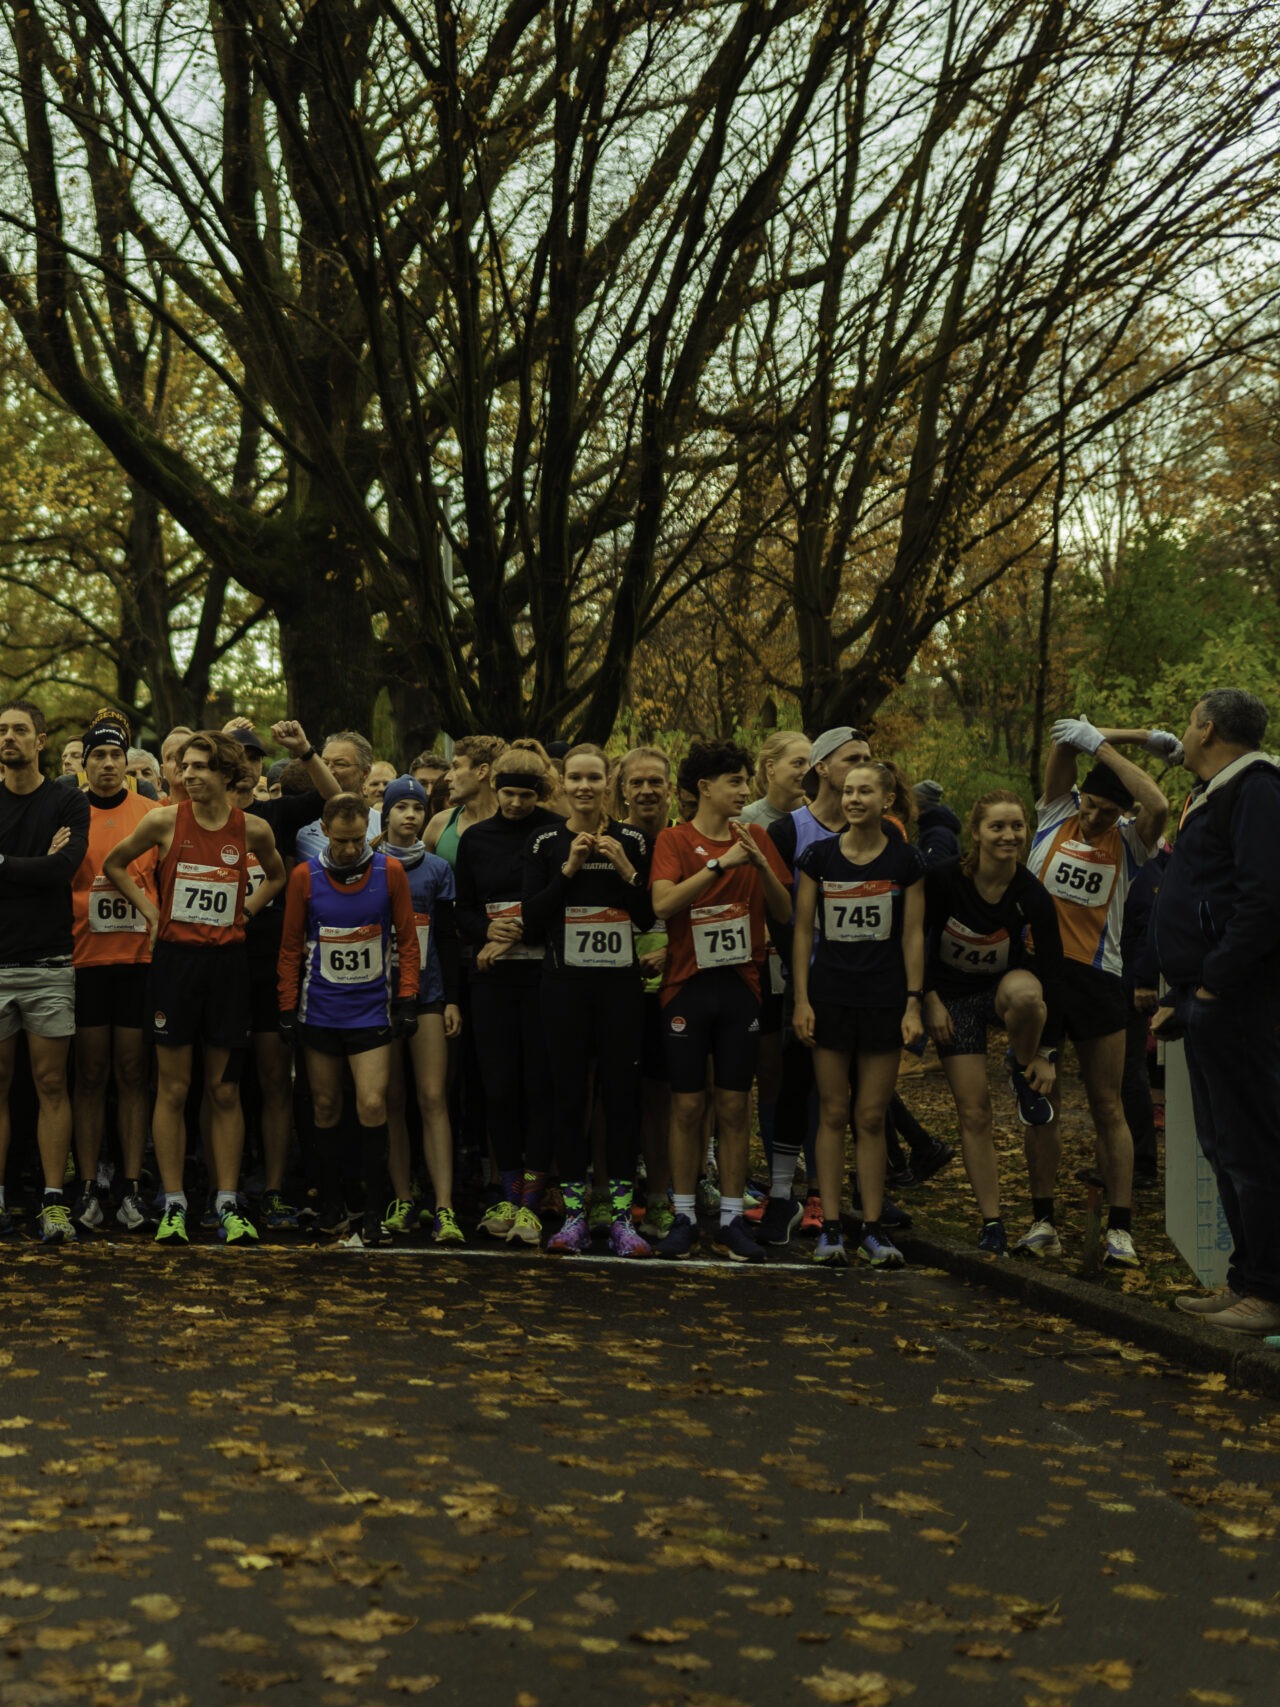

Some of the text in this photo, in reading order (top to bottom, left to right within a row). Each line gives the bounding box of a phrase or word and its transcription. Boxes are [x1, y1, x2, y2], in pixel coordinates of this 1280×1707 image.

[581, 862, 616, 870] RIATHLO
[1055, 862, 1103, 894] 558
[98, 898, 137, 920] 661
[185, 887, 228, 913] 750
[833, 905, 881, 928] 745
[575, 930, 622, 954] 780
[704, 927, 746, 953] 751
[330, 948, 371, 971] 631
[951, 942, 998, 965] 744
